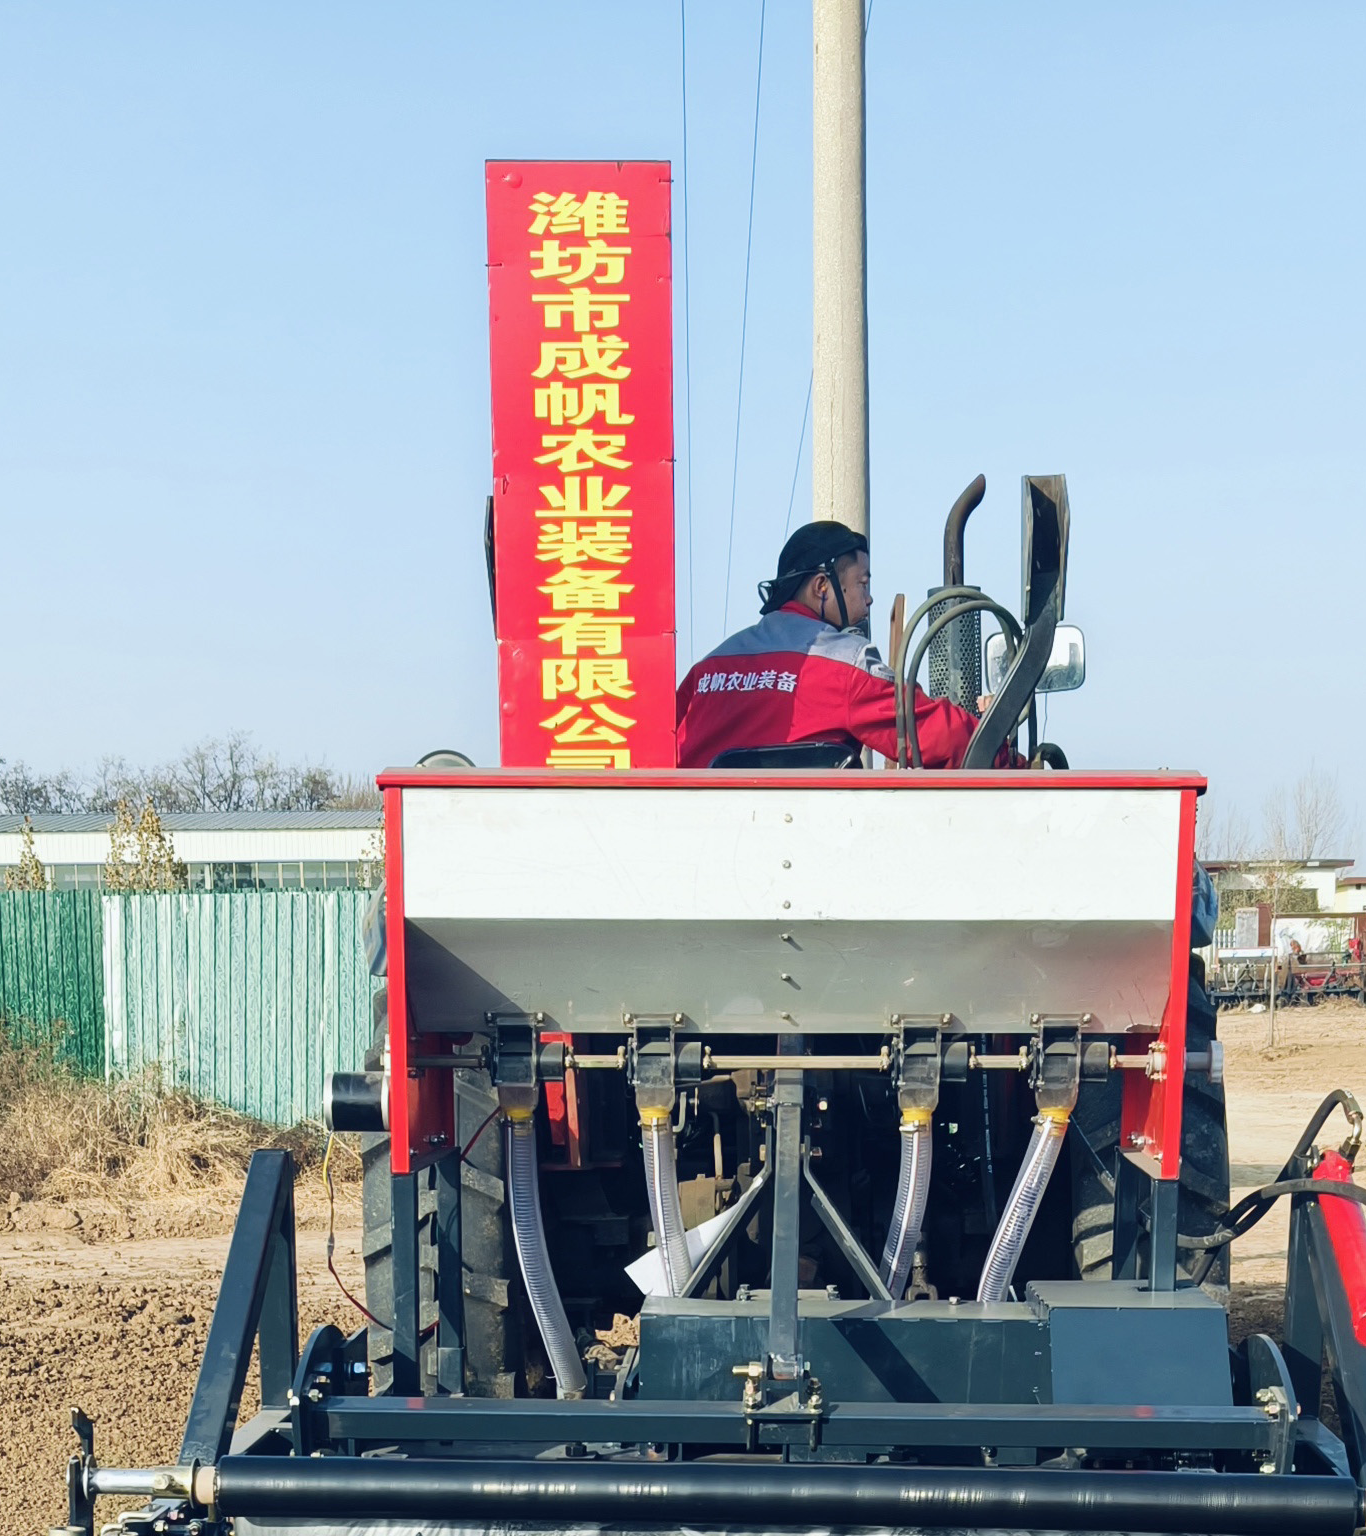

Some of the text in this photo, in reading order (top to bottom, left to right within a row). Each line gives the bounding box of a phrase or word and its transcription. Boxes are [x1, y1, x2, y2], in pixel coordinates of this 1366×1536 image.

[697, 669, 797, 693] 成帆农业装备
